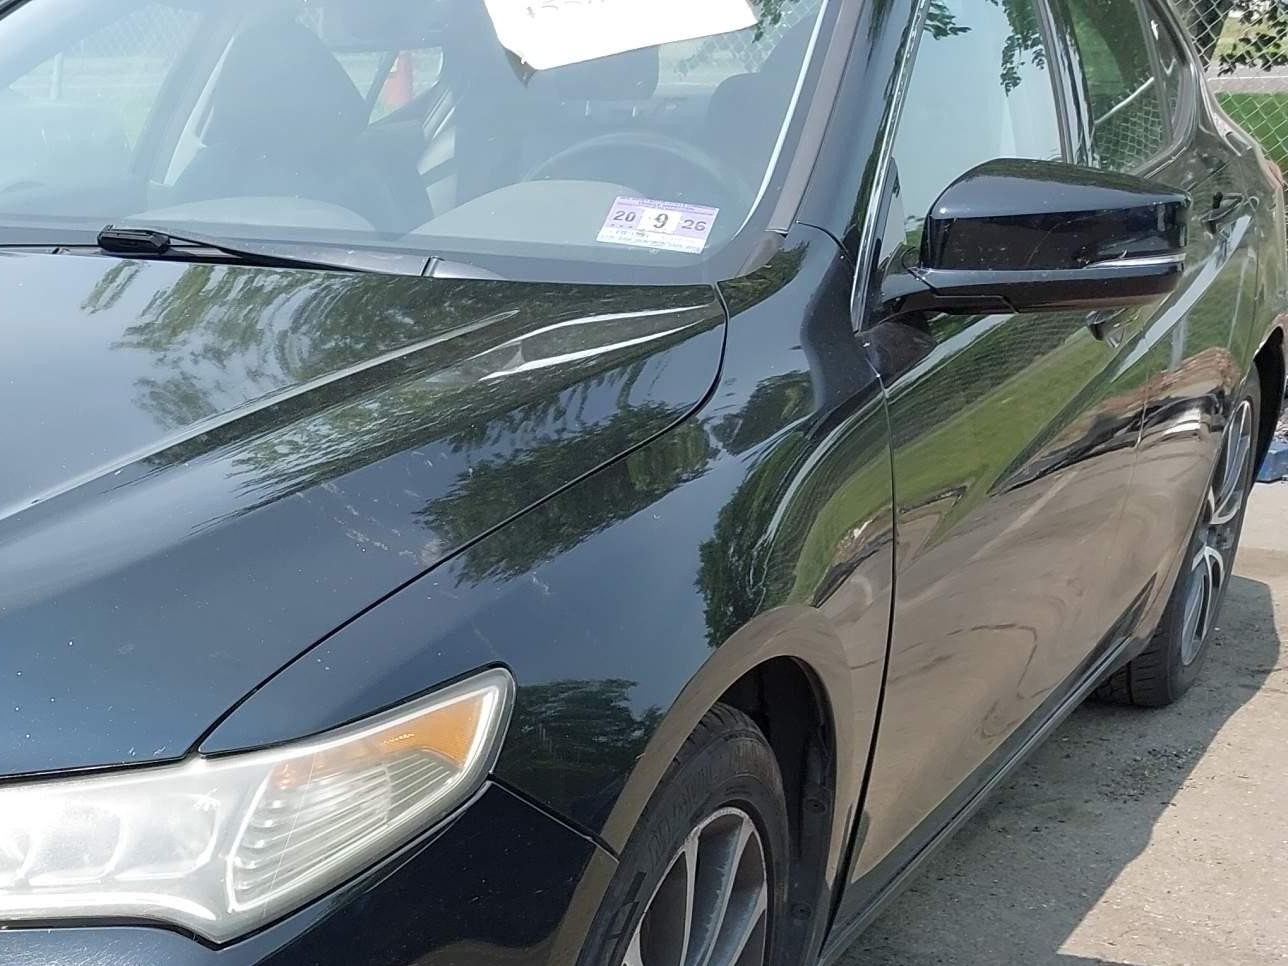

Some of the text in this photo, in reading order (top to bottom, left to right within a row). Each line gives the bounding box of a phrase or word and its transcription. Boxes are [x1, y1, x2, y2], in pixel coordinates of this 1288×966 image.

[613, 210, 707, 232] 20 9 26
